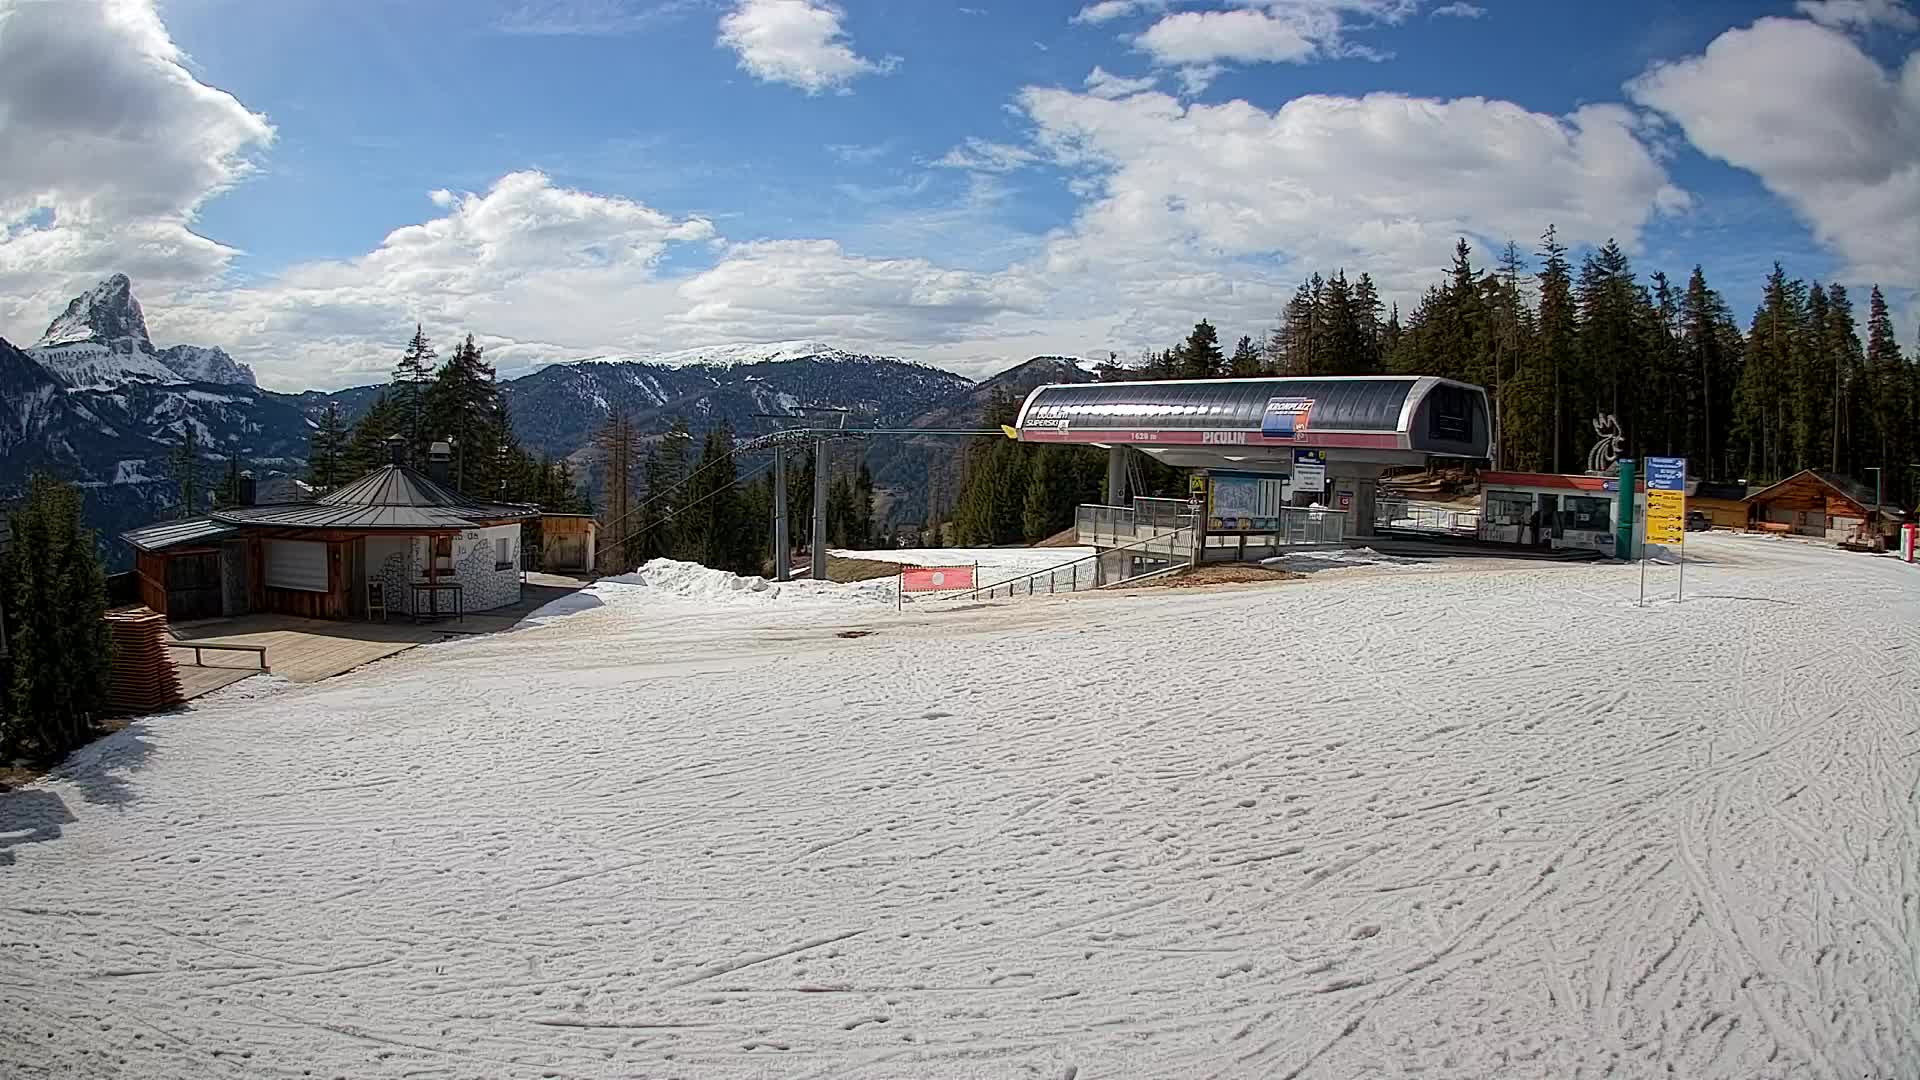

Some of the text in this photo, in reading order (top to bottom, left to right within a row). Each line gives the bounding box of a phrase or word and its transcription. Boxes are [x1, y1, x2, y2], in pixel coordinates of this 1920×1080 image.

[1267, 402, 1312, 411] KRONPLATZ
[1025, 419, 1058, 427] SUPERSKI
[1203, 431, 1245, 444] PICULIN
